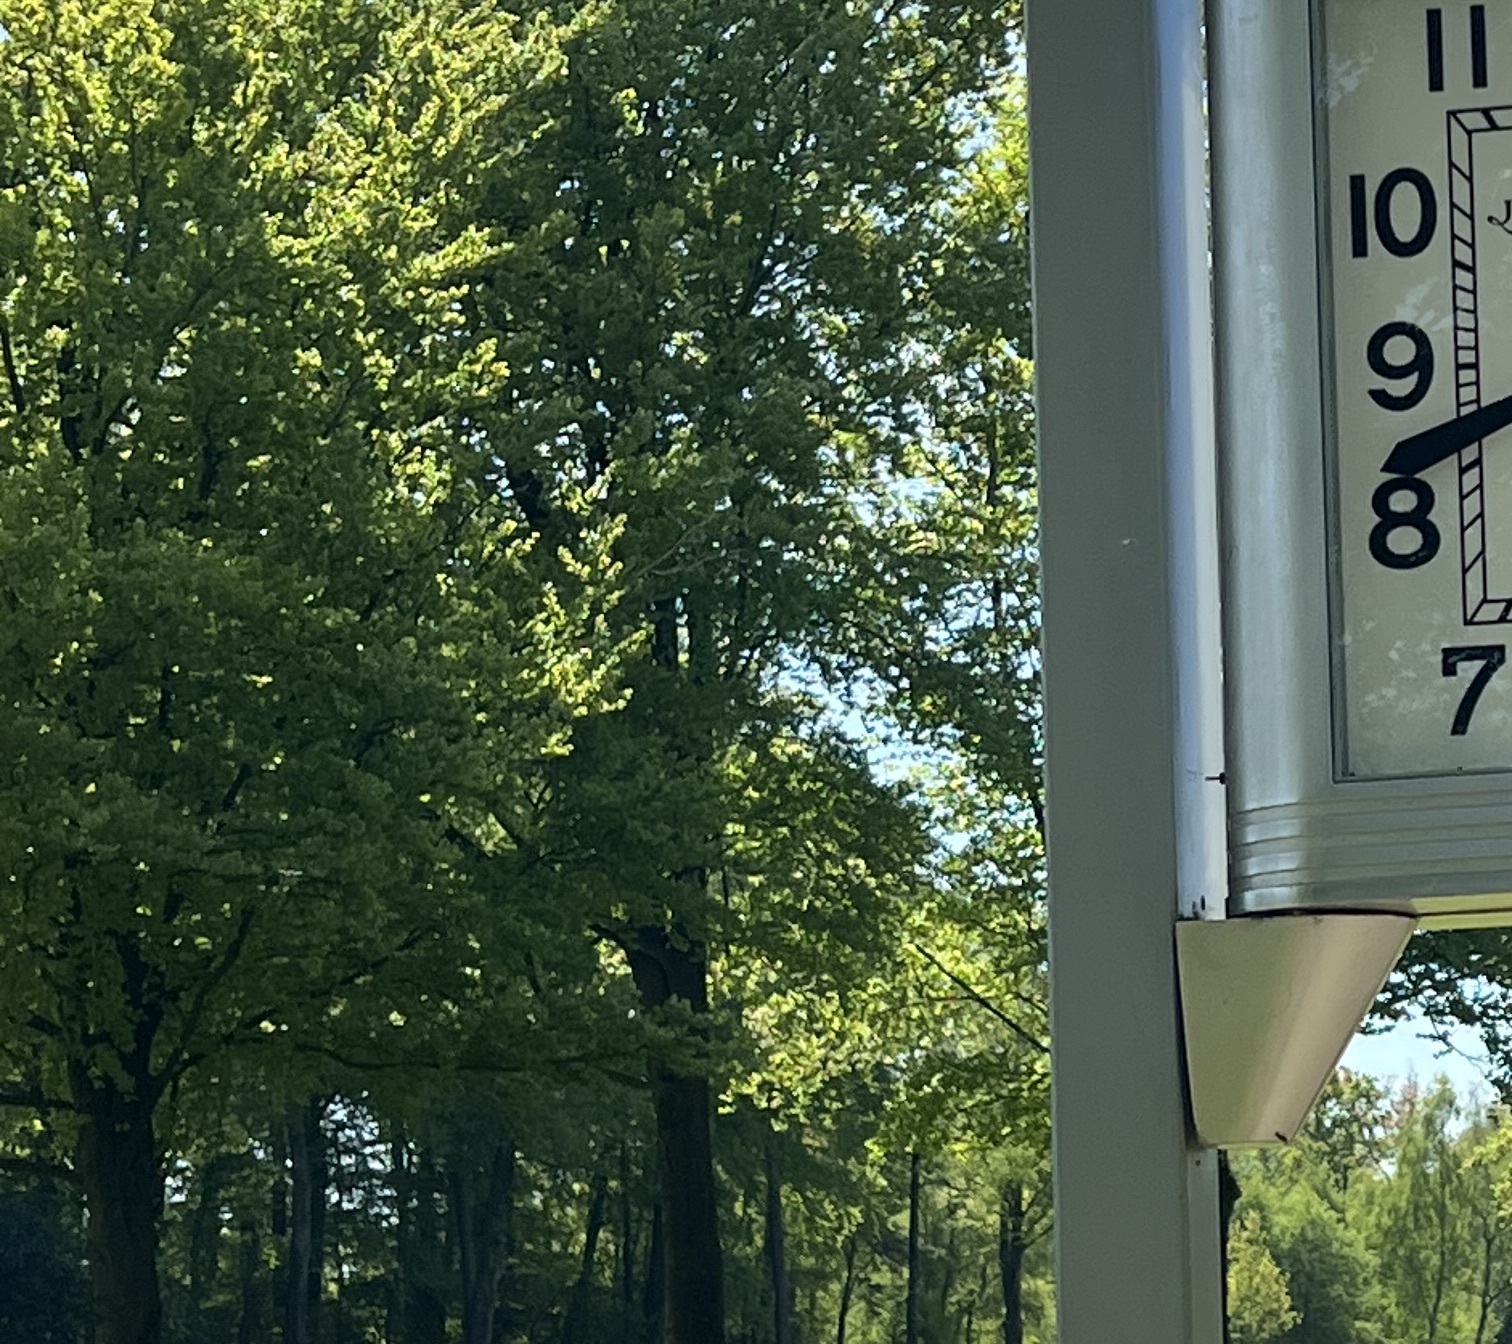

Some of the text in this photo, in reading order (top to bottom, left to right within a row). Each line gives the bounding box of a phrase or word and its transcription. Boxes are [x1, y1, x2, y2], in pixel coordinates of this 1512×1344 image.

[1426, 5, 1487, 92] 11
[1349, 167, 1437, 258] 10
[1366, 321, 1434, 411] 9
[1368, 474, 1441, 570] 8
[1441, 644, 1506, 737] 7
